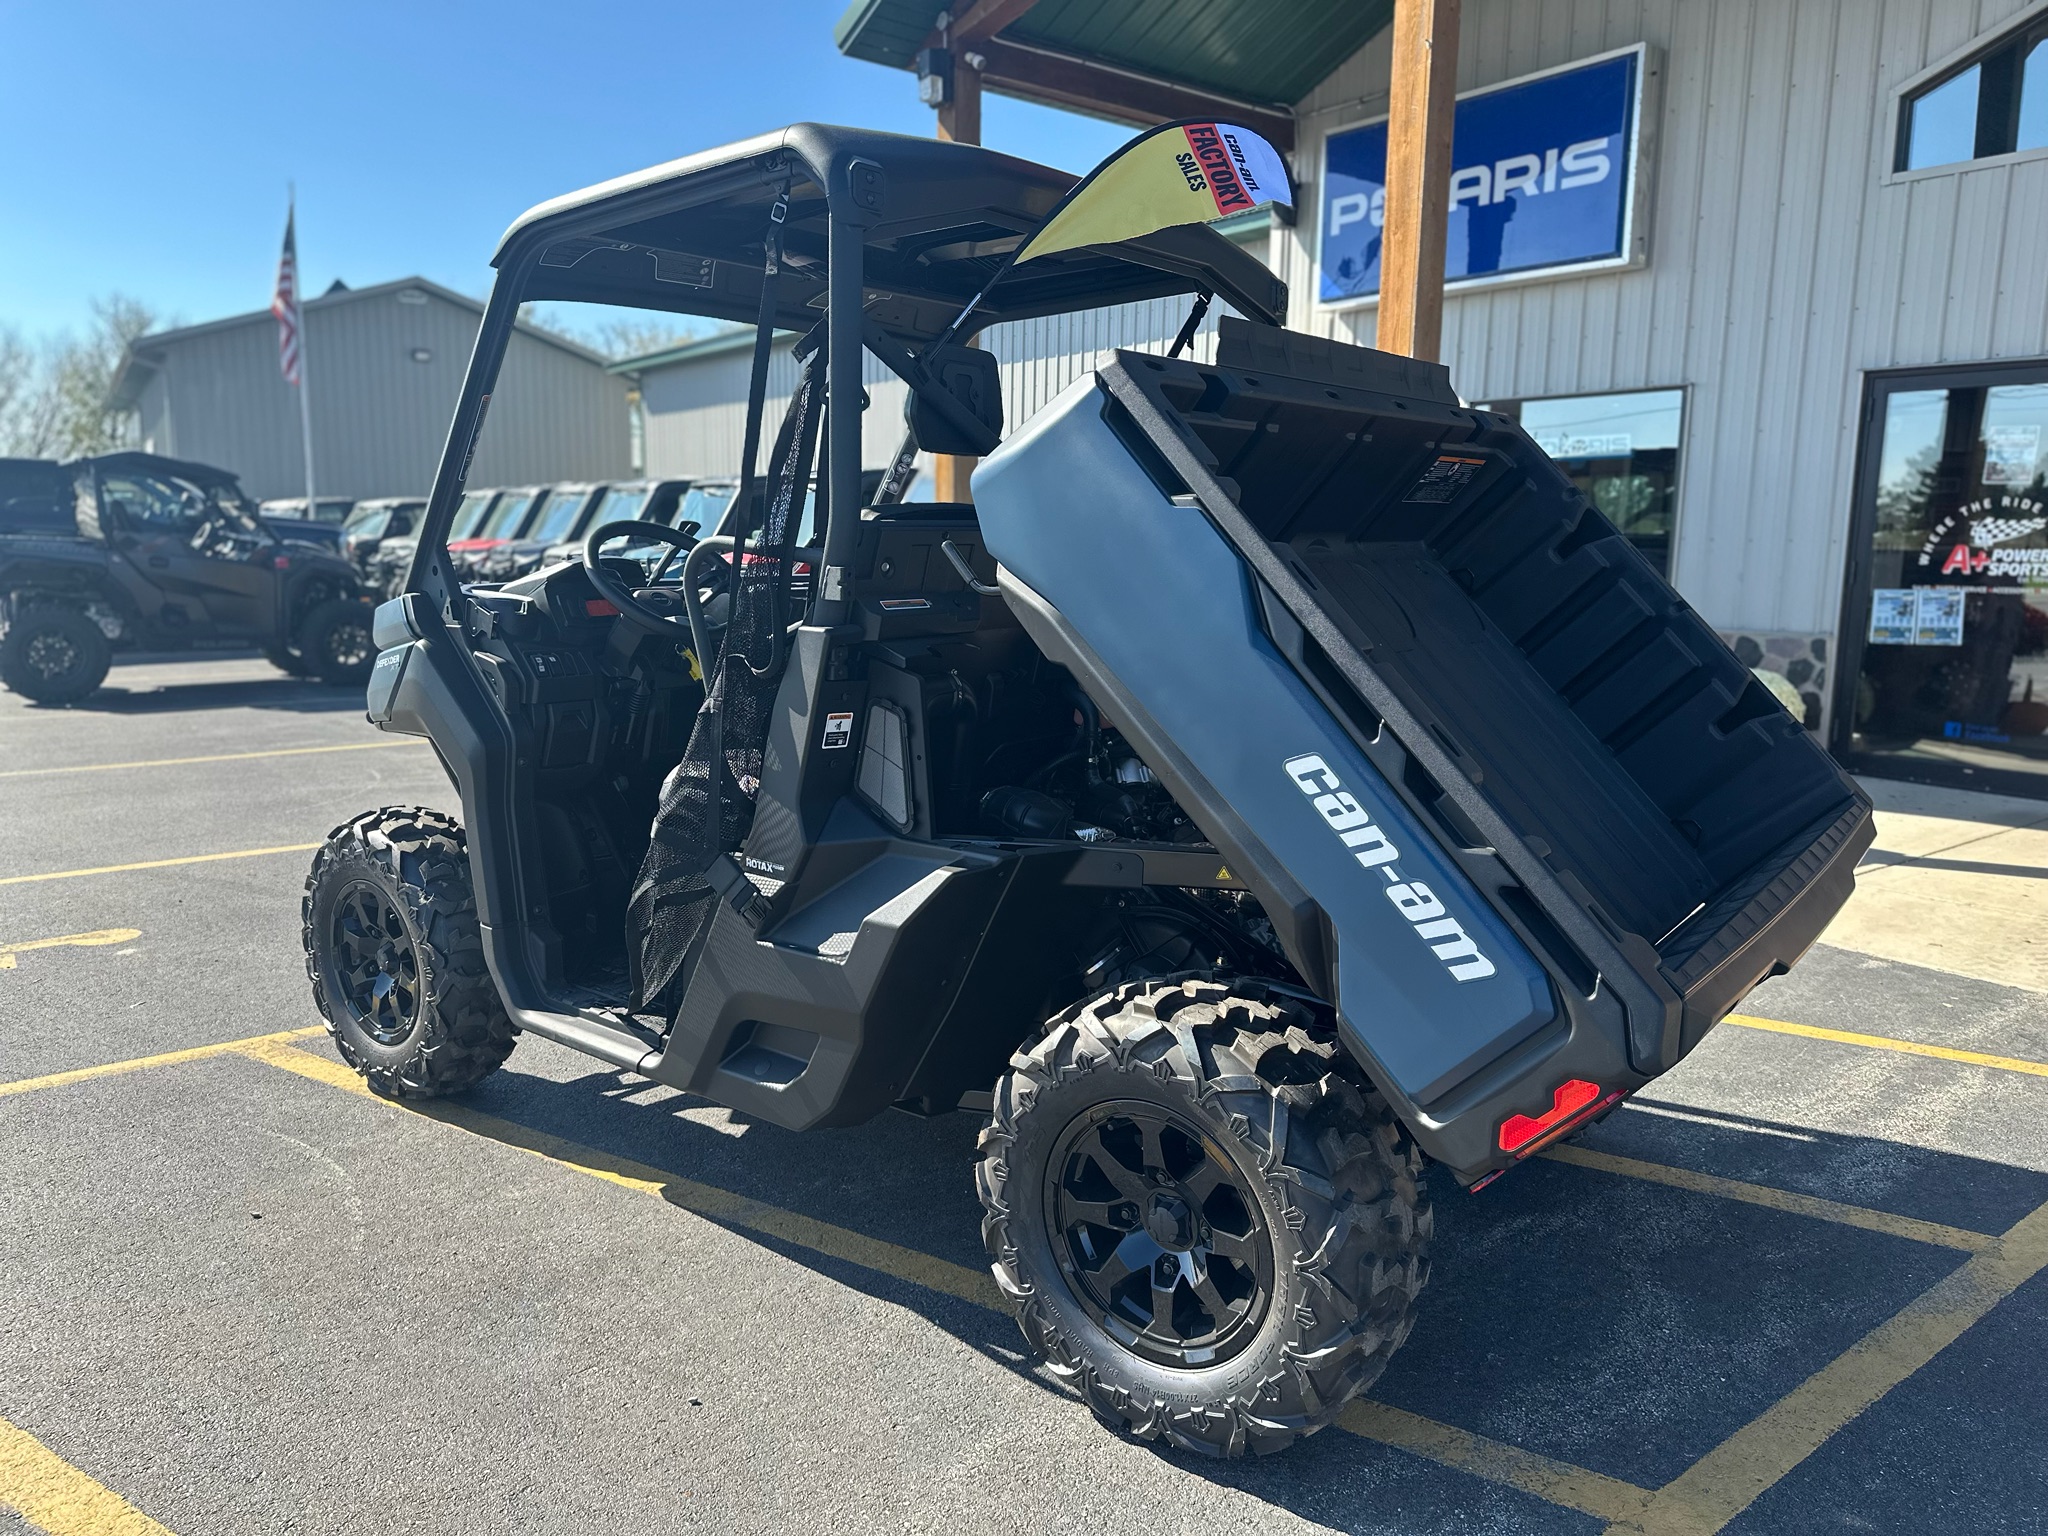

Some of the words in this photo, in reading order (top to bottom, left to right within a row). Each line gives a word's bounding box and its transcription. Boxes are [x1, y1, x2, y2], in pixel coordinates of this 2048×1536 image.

[1175, 152, 1207, 192] SALES
[1189, 127, 1249, 207] FACTORY
[1224, 134, 1260, 192] can-am
[1330, 137, 1611, 237] PARIS
[1918, 516, 1955, 566] WHERE
[1959, 498, 1992, 517] THE
[2001, 496, 2043, 514] RIDE
[1941, 544, 1991, 575] A+
[1991, 548, 2048, 562] POWER
[1987, 562, 2048, 577] SPORTS
[376, 654, 399, 669] DEFENDER
[745, 856, 773, 873] ROTAX
[1284, 755, 1496, 983] can-am
[1227, 1341, 1276, 1390] FORCE
